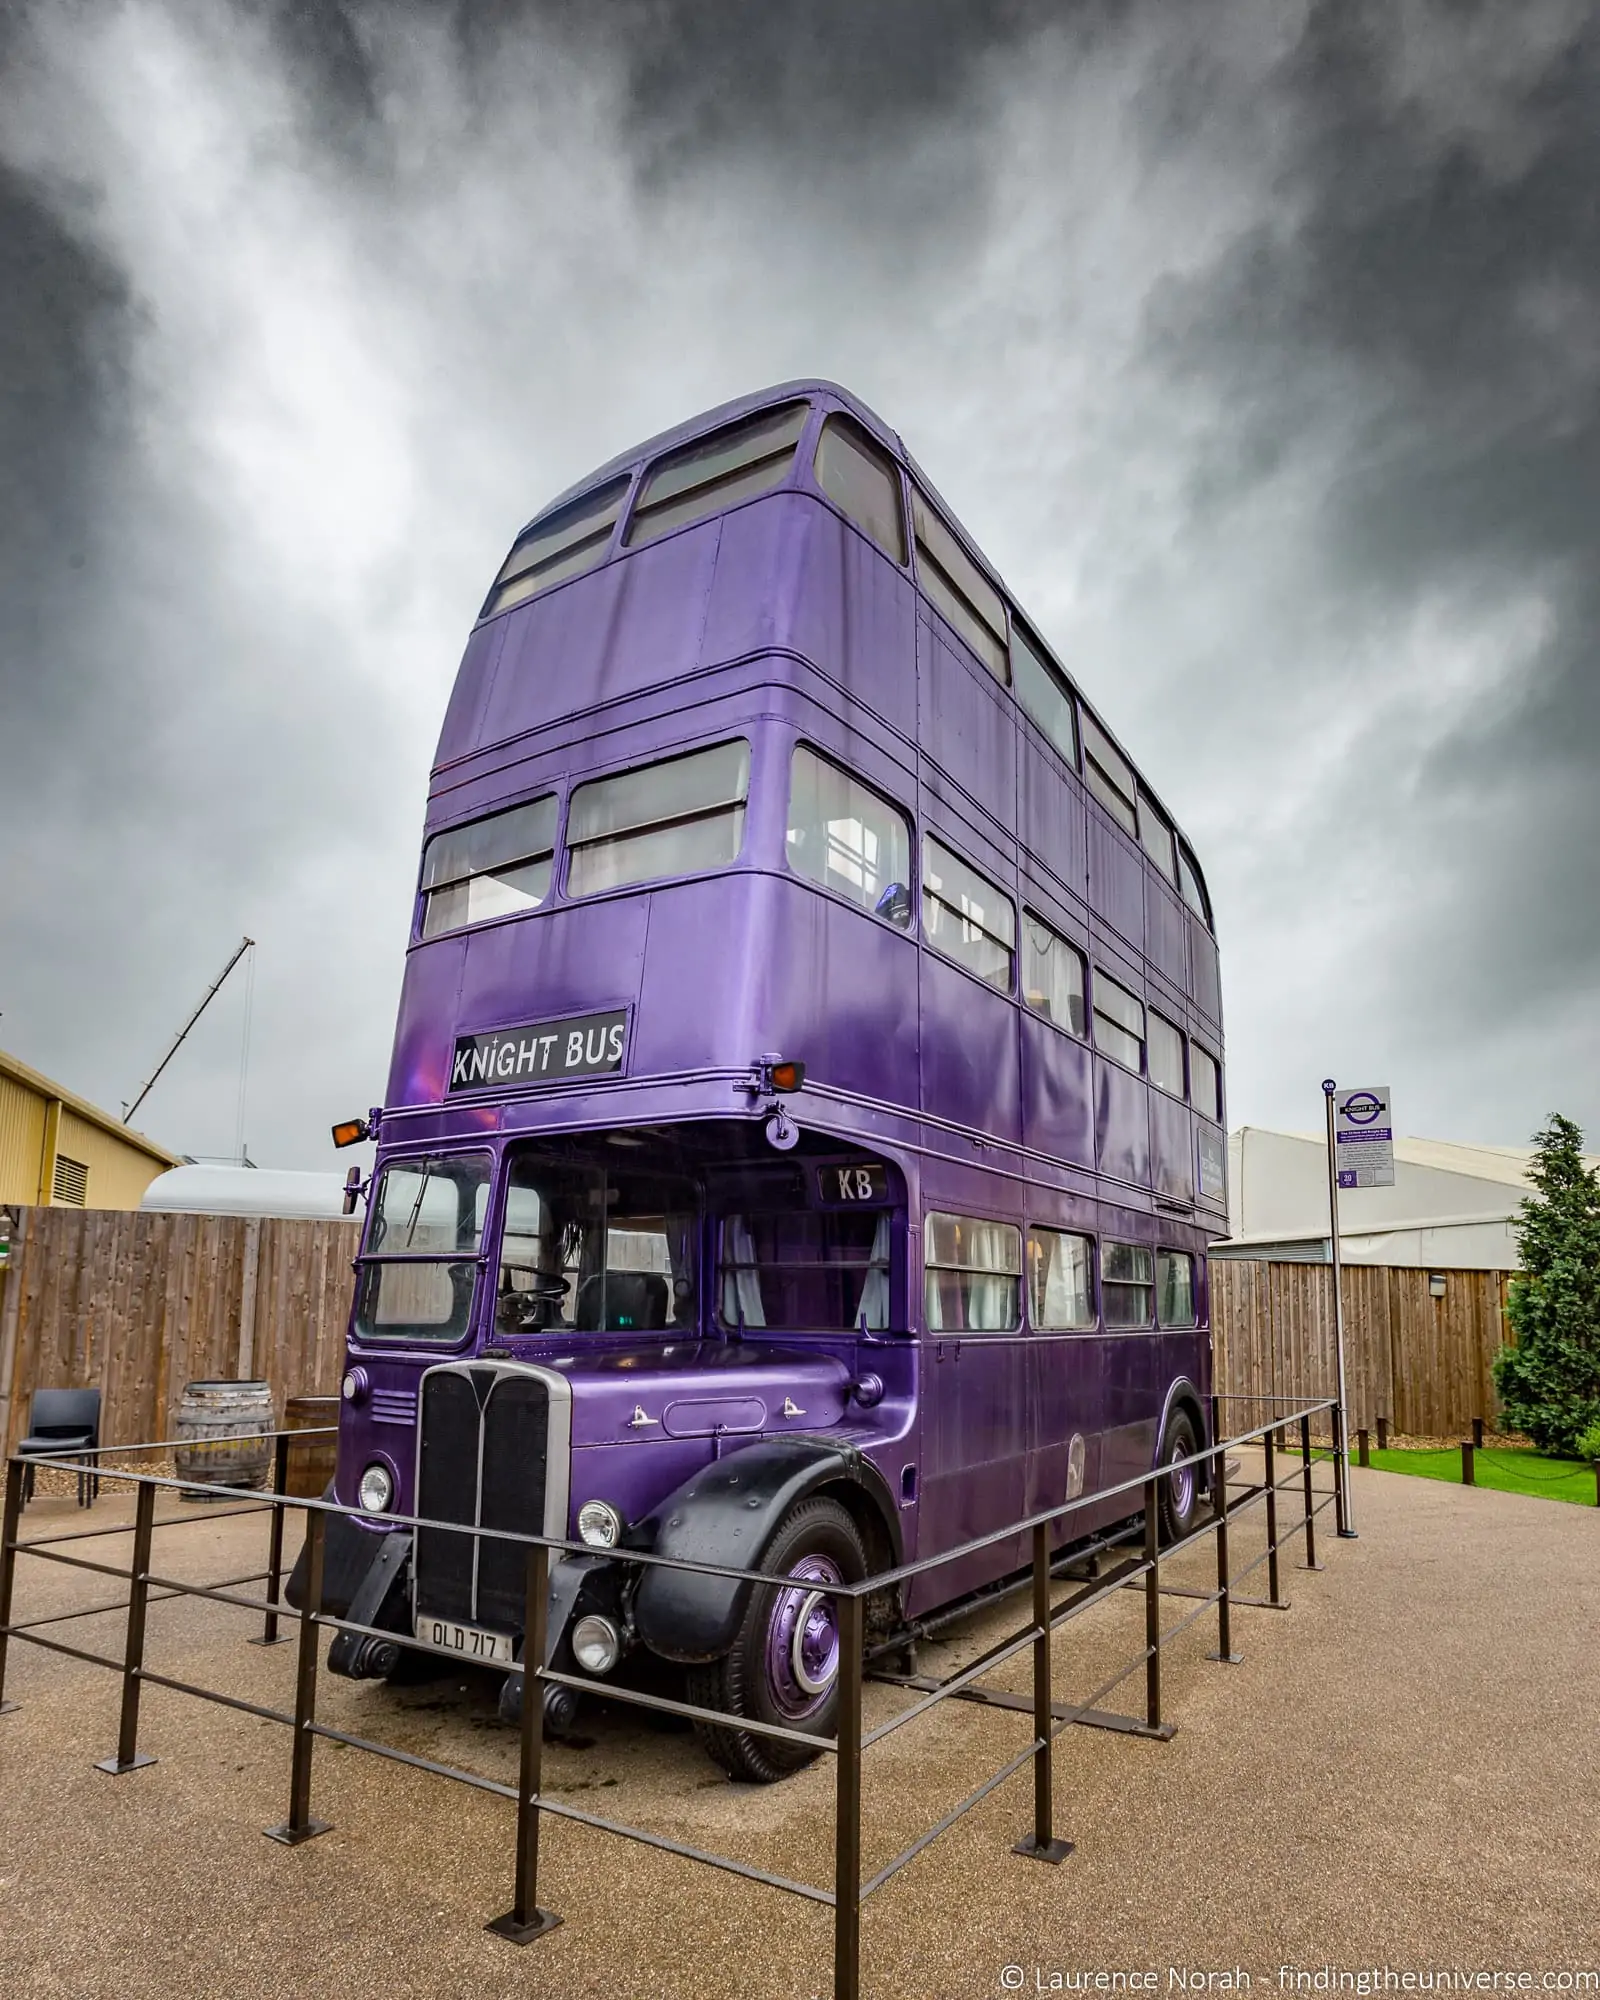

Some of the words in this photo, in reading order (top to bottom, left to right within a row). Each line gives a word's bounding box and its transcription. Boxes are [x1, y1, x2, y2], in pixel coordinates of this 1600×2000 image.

[565, 1024, 625, 1067] BUS
[1345, 1105, 1368, 1113] KNIGHT
[838, 1169, 873, 1200] KB
[433, 1622, 464, 1650] OLD
[470, 1631, 497, 1658] 717
